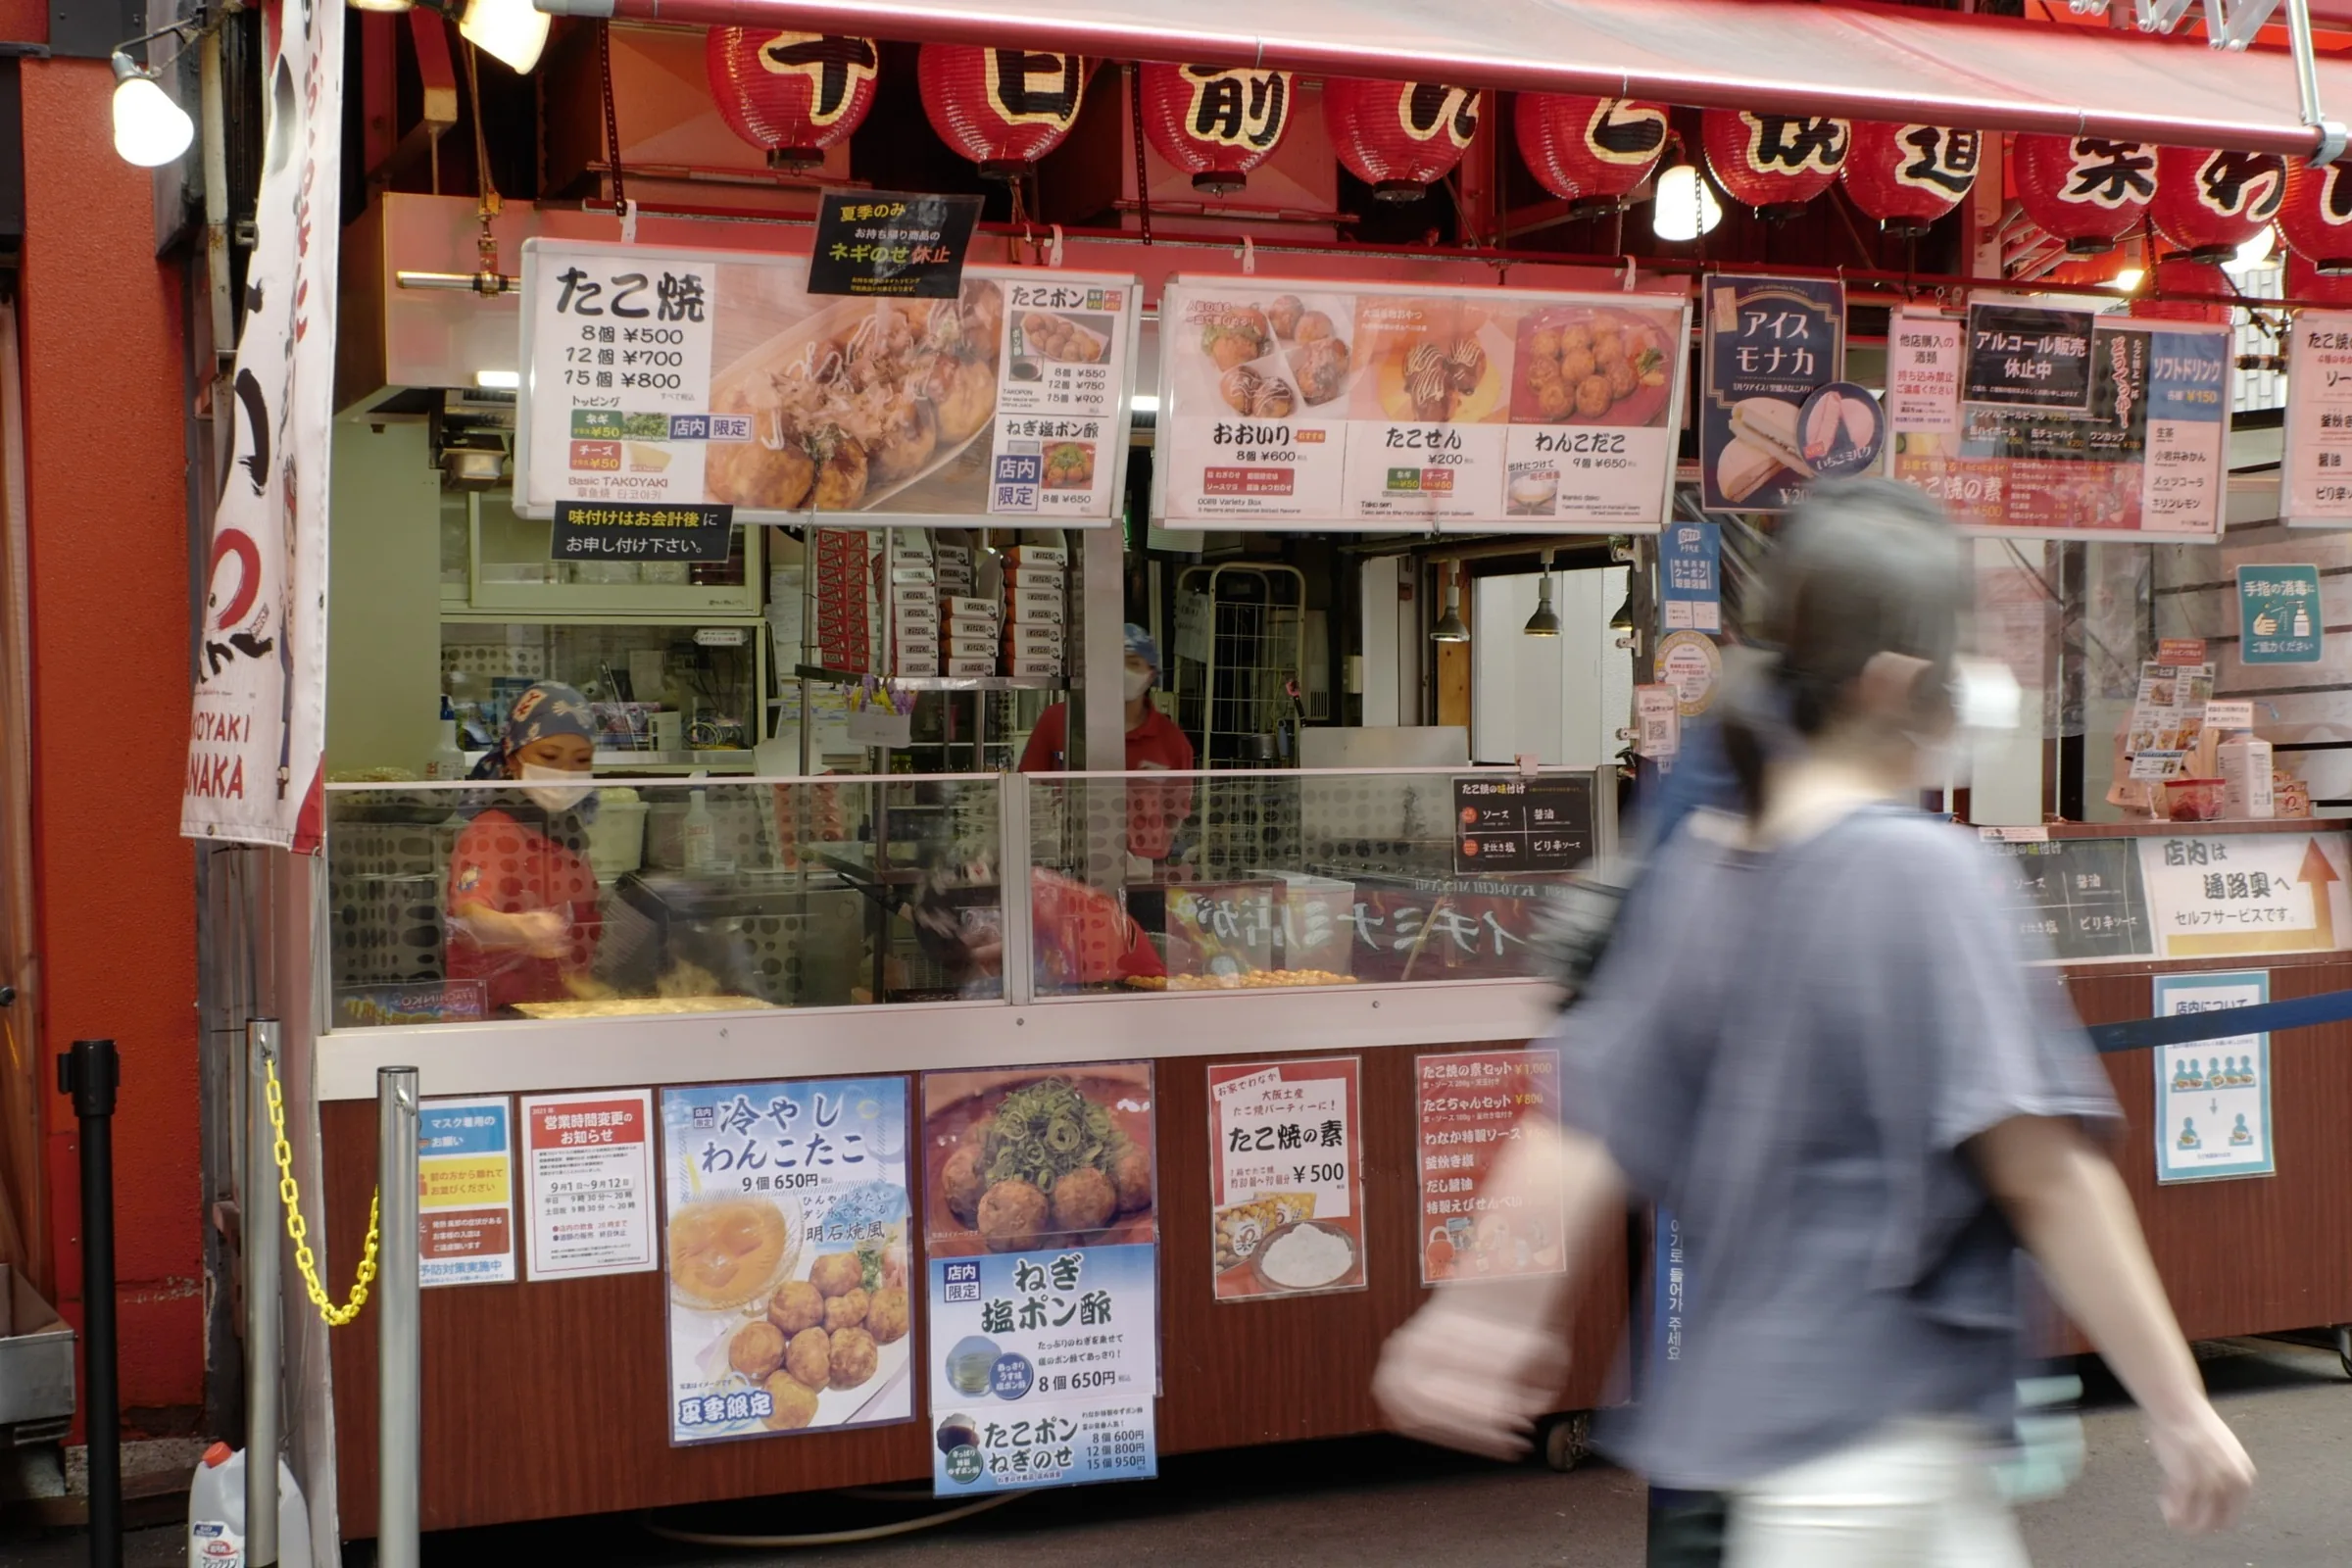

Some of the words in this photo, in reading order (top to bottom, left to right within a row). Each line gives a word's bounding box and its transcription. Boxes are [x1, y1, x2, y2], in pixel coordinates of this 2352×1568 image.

[840, 203, 906, 222] 夏季のみ
[855, 227, 941, 242] お持ち帰り商品の
[829, 243, 909, 263] ネギのせ
[911, 245, 951, 265] 休止
[557, 267, 705, 322] たこ焼
[1011, 285, 1085, 309] たこポン
[1744, 311, 1810, 340] アイス
[581, 325, 615, 343] 8個
[623, 328, 684, 345] ¥500
[1899, 333, 1955, 349] 他店購入の
[2308, 332, 2352, 350] たこ焼
[1976, 331, 2086, 358] アルコール販売
[565, 347, 614, 367] 12個
[622, 350, 683, 368] ¥700
[1736, 346, 1813, 375] モナカ
[1054, 368, 1071, 377] 8個
[1077, 368, 1105, 378] ¥550
[1897, 370, 1954, 383] 持ち込み禁止
[2004, 358, 2052, 380] 休止中
[2154, 357, 2222, 382] ソフトドリンク
[564, 369, 612, 388] 15個
[620, 372, 682, 390] ¥800
[1048, 379, 1070, 390] 12個
[1076, 380, 1104, 390] ¥750
[572, 395, 620, 407] トッピング
[1047, 392, 1069, 403] 15個
[1074, 394, 1103, 404] ¥900
[2186, 390, 2218, 404] ¥150
[674, 419, 706, 437] 店内
[713, 419, 747, 437] 限定
[1006, 419, 1100, 439] ねぎ塩ポン酢
[1213, 422, 1291, 446] おおいり
[2156, 427, 2175, 439] 生茶
[1386, 426, 1462, 450] たこせん
[1536, 431, 1627, 453] わんこだこ
[579, 444, 613, 457] チーズ
[1237, 451, 1256, 462] 8個
[1261, 451, 1296, 462] ¥600
[1428, 454, 1463, 465] ¥200
[1816, 446, 1872, 470] いちごミルク
[999, 458, 1035, 479] 店内
[1507, 460, 1555, 471] 出汁につけて
[1573, 458, 1592, 468] 9個
[1595, 459, 1627, 468] ¥650
[568, 476, 600, 487] Basic
[603, 476, 668, 488] TAKOYAKI
[2153, 475, 2205, 488] メッツコーラ
[999, 486, 1033, 506] 限定
[1042, 494, 1059, 504] 8個
[1062, 494, 1092, 505] ¥650
[2151, 498, 2201, 510] キリンレモン
[568, 510, 718, 527] 味付けはお会計後に
[566, 536, 703, 555] お申し付け下さい。
[2244, 580, 2316, 597] 手指の消毒に
[2252, 640, 2314, 654] ご協力ください
[1462, 783, 1526, 795] たこ焼の味付け
[1483, 809, 1510, 819] ソース
[1534, 840, 1581, 852] ピリ辛ソース
[2163, 840, 2228, 866] 店内は
[2202, 871, 2291, 900] 通路奥へ
[2174, 907, 2295, 926] セルフサービスです。
[1423, 1061, 1512, 1079] たこ焼の素セット
[1218, 1073, 1277, 1097] お家でわなか
[1262, 1088, 1303, 1101] 大阪土産
[1423, 1094, 1511, 1112] たこちゃんセット
[695, 1107, 712, 1118] 店内
[719, 1093, 845, 1137] 冷やし
[1233, 1100, 1336, 1117] たこ焼パーティーに！
[431, 1115, 496, 1129] マスク着用の
[544, 1110, 633, 1130] 営業時間変更の
[432, 1136, 464, 1148] お願い
[561, 1129, 613, 1145] お知らせ
[1228, 1119, 1344, 1152] たこ焼の素
[1425, 1127, 1522, 1146] わなか特製ソース
[702, 1132, 865, 1174] わんこたこ
[1294, 1162, 1345, 1184] ¥500
[430, 1184, 496, 1196] お並びください
[742, 1176, 770, 1192] 9個
[774, 1173, 819, 1190] 650円
[803, 1192, 889, 1206] ひんやり冷たい
[804, 1204, 886, 1220] ダシ氷で食べる
[806, 1220, 886, 1243] 明石焼風
[947, 1264, 977, 1281] 店内
[1014, 1253, 1083, 1294] ねぎ
[948, 1282, 977, 1299] 限定
[1669, 1267, 1685, 1313] 들어가
[982, 1290, 1113, 1334] 塩ポン酢
[1038, 1334, 1125, 1350] たっぷりのねぎを乗せて
[1667, 1316, 1683, 1360] 주세요
[1039, 1375, 1067, 1393] 8個
[1071, 1370, 1115, 1390] 650円
[679, 1392, 773, 1424] 夏季限定
[984, 1415, 1078, 1449] たこポン
[1092, 1432, 1111, 1444] 8個
[1114, 1430, 1145, 1442] 600円
[1087, 1445, 1111, 1457] 12個
[1114, 1443, 1145, 1455] 800円
[988, 1446, 1073, 1474] ねぎのせ
[1087, 1457, 1112, 1470] 15個
[1115, 1455, 1146, 1468] 950円
